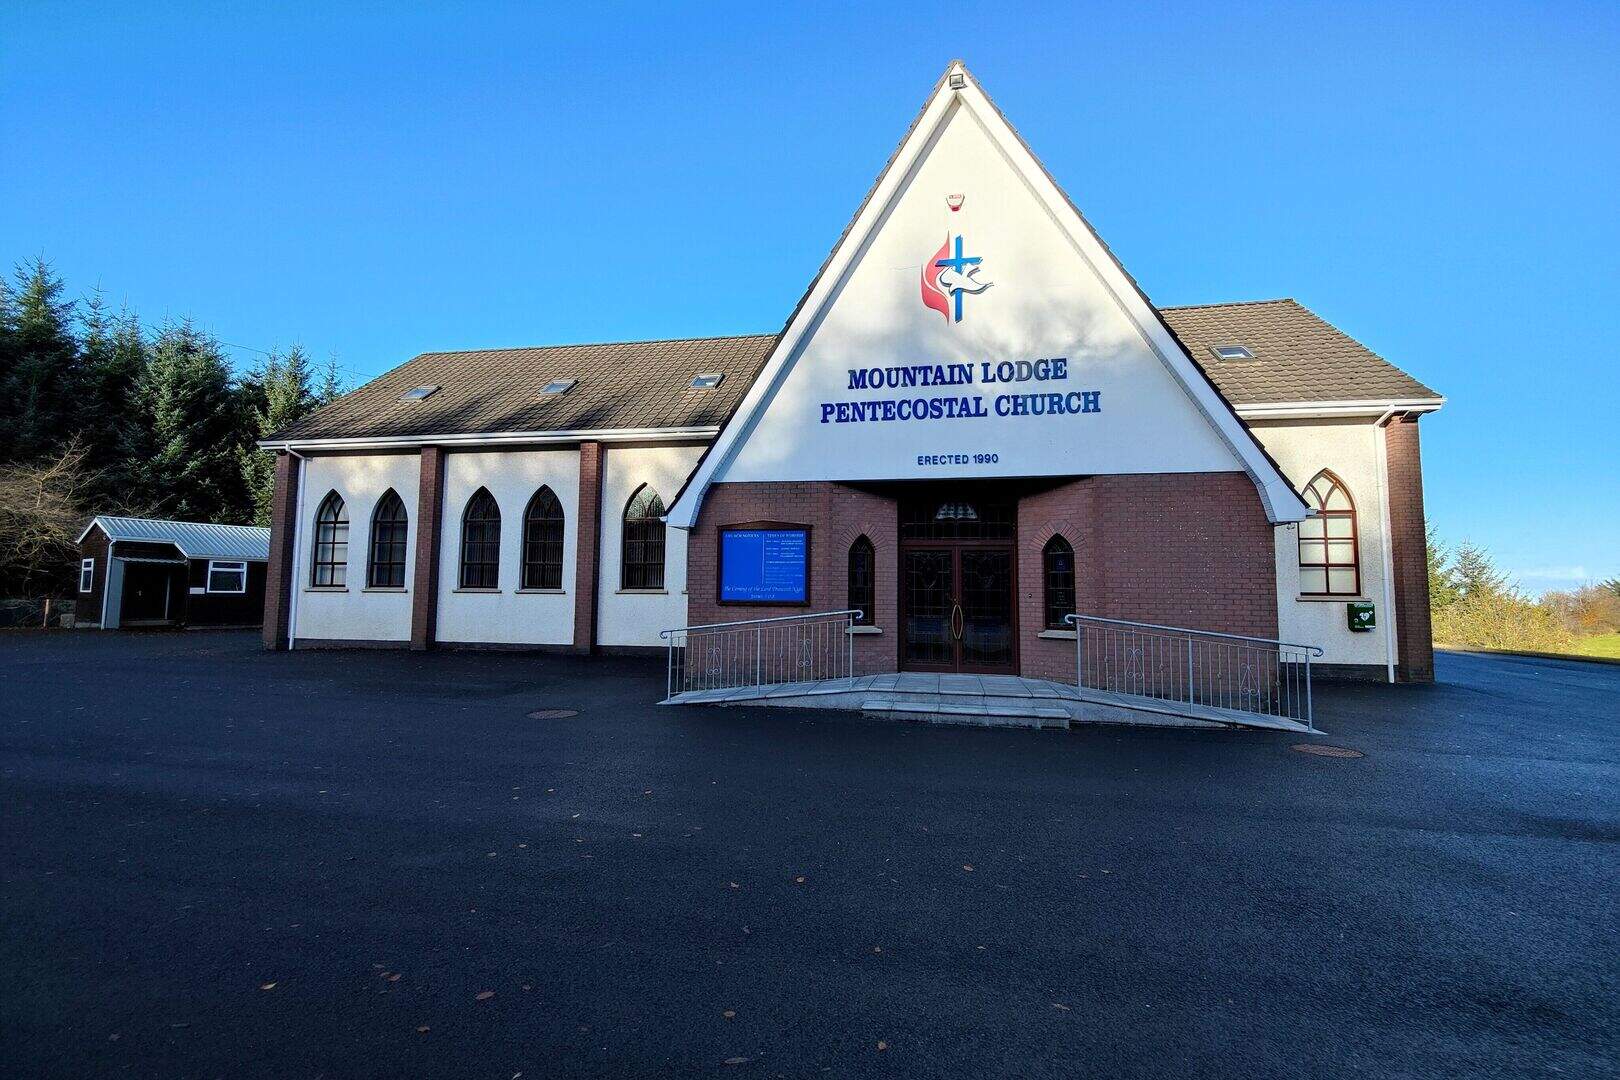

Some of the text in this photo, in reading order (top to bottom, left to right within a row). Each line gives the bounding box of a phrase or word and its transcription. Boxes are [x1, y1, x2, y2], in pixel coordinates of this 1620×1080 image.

[848, 358, 1067, 389] MOUNTAIN LODGE
[820, 391, 1101, 424] PENTECOSTAL CHURCH
[917, 453, 999, 465] ERECTED 1990
